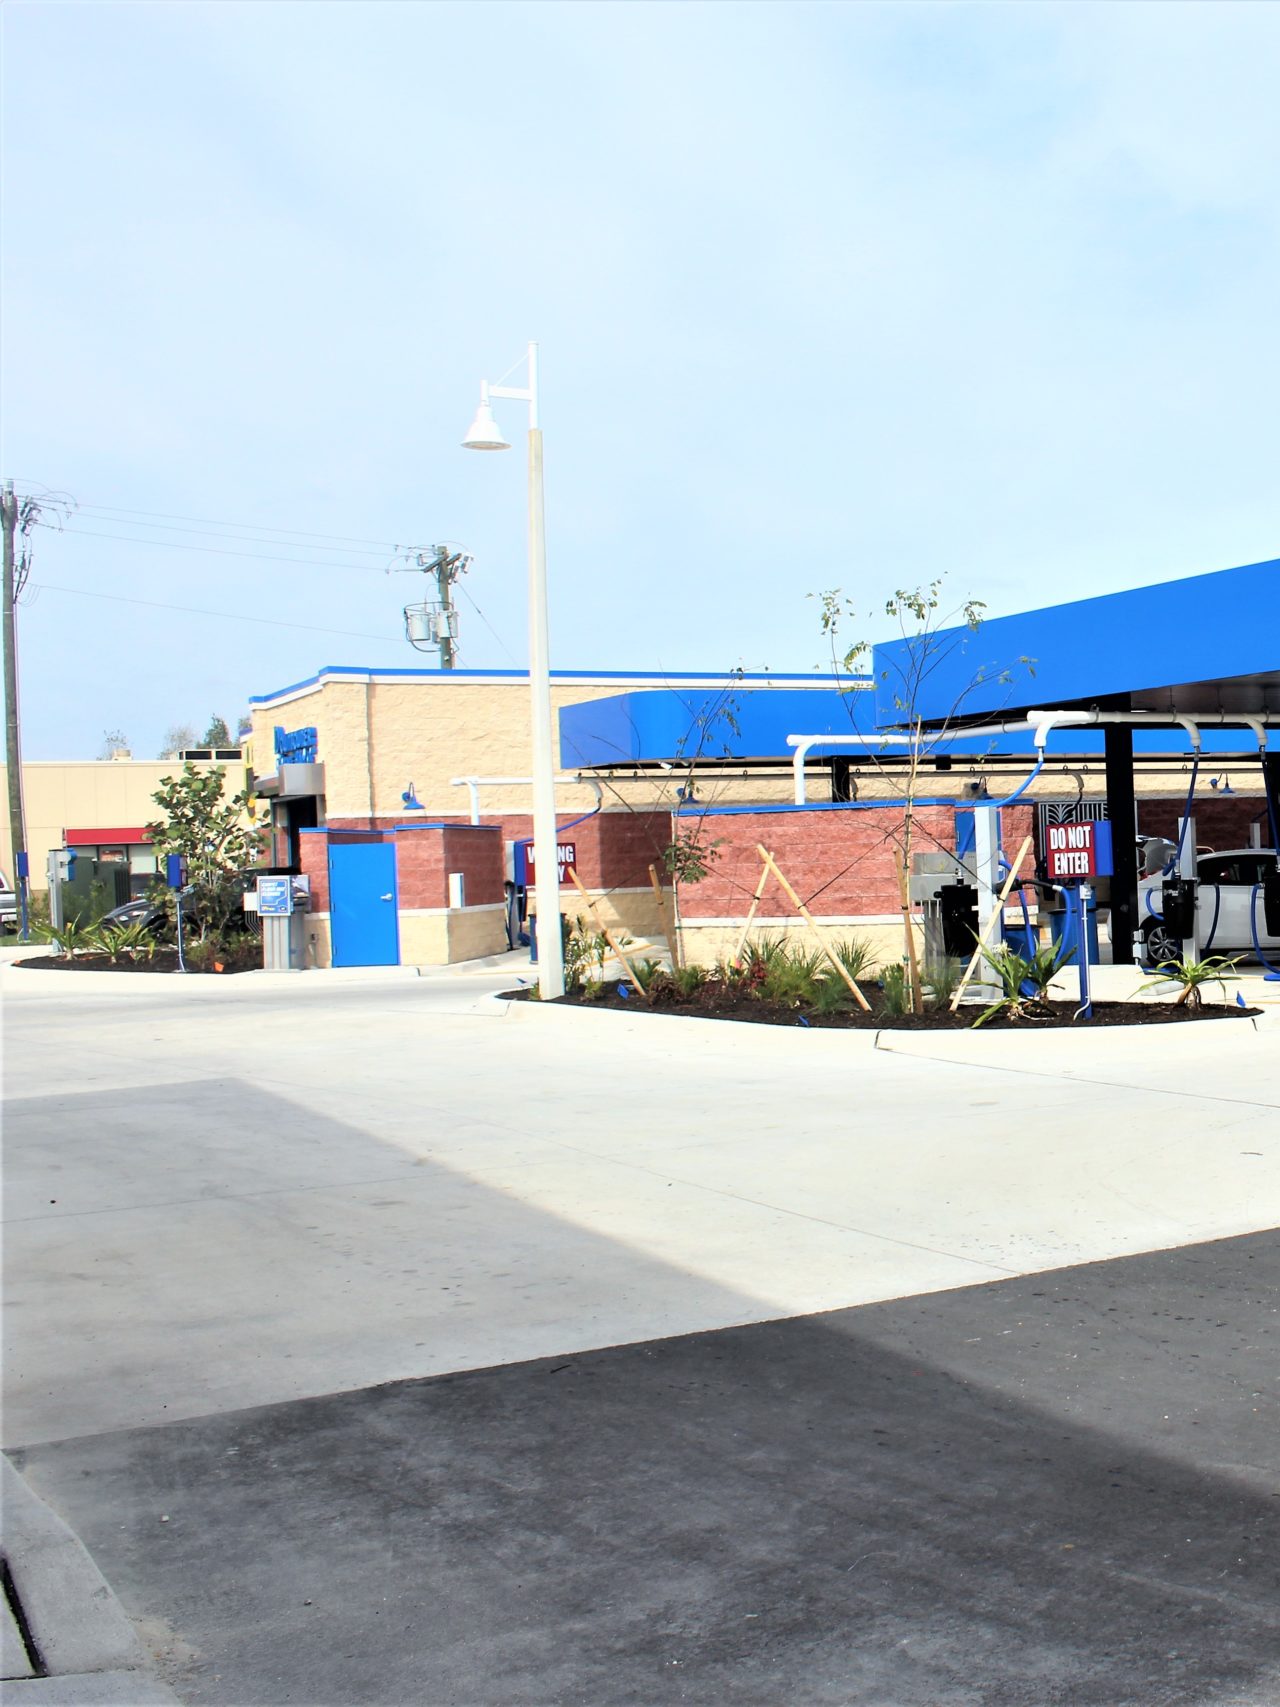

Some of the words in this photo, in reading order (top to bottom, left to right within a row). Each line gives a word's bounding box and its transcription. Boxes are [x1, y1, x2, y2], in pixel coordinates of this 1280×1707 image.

[1050, 827, 1066, 850] DO
[1067, 825, 1091, 849] NOT
[526, 845, 574, 863] WNG
[1054, 851, 1089, 875] ENTER
